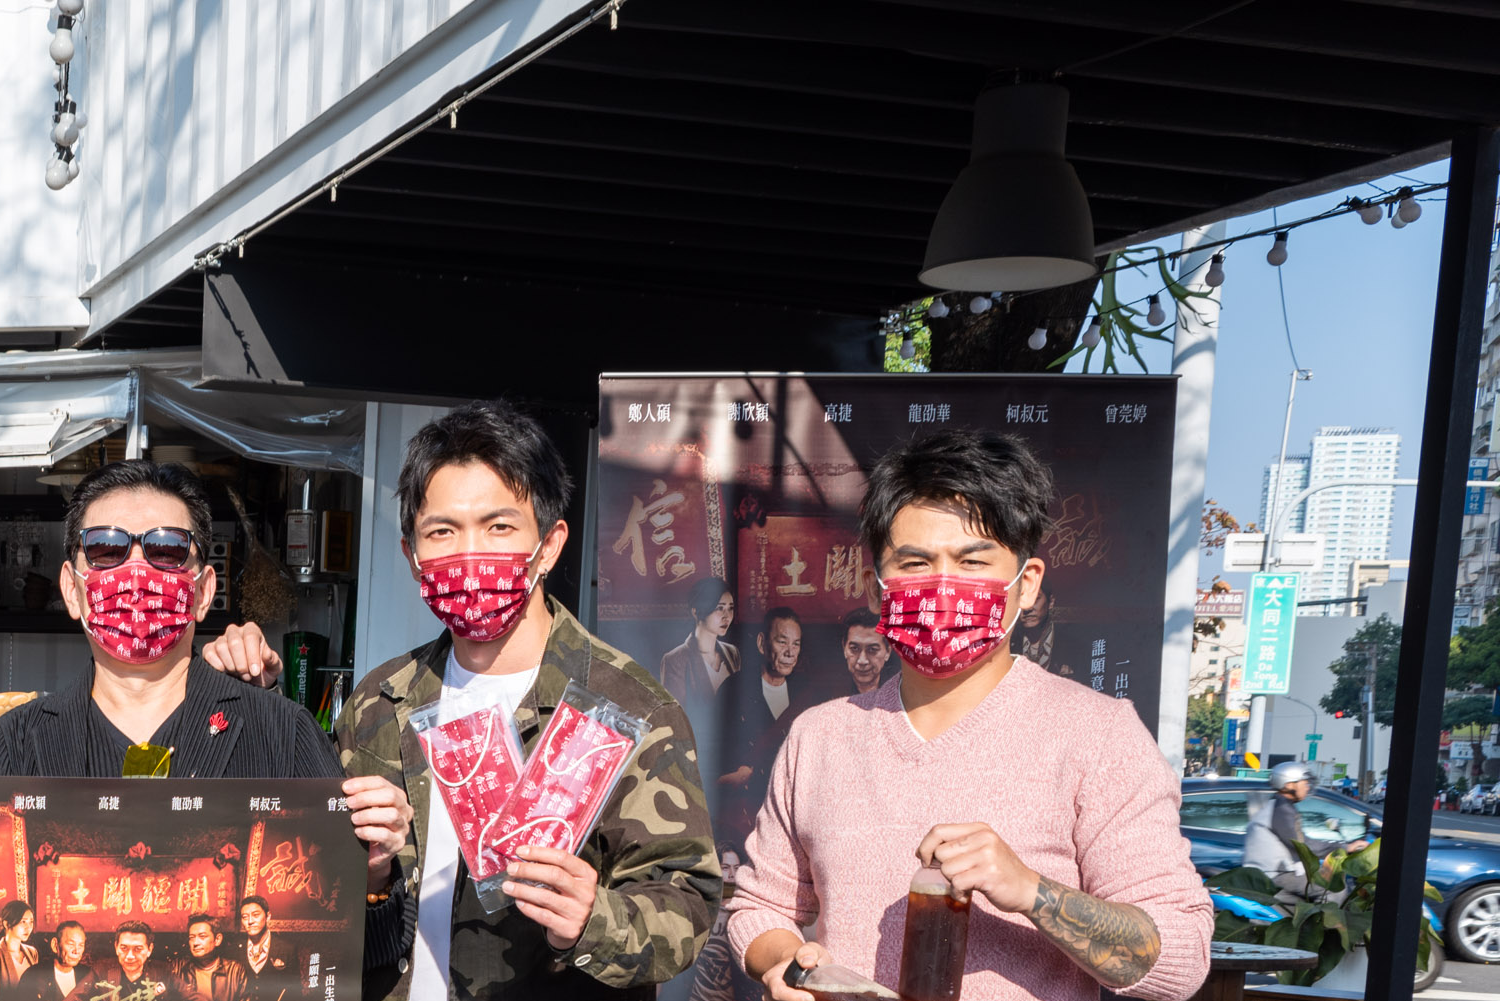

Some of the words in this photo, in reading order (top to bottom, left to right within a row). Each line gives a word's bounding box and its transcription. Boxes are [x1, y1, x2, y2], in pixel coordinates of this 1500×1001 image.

[628, 403, 671, 422] 鄭人碩
[727, 402, 769, 422] 謝欣穎
[824, 403, 853, 422] 高捷
[908, 403, 951, 423] 龍劭華
[1006, 404, 1049, 424] 柯叔元
[1105, 403, 1147, 424] 曾莞婷
[612, 478, 696, 585] 信
[1258, 590, 1283, 661] 大同二路
[1253, 671, 1278, 681] Tong
[1258, 663, 1273, 671] Da
[297, 659, 308, 703] eineken
[14, 795, 46, 810] 謝欣穎
[98, 796, 120, 811] 高捷
[171, 797, 203, 811] 龍劭華
[249, 797, 281, 811] 柯叔元
[327, 797, 355, 812] 曾莞
[308, 953, 320, 988] 誰願意
